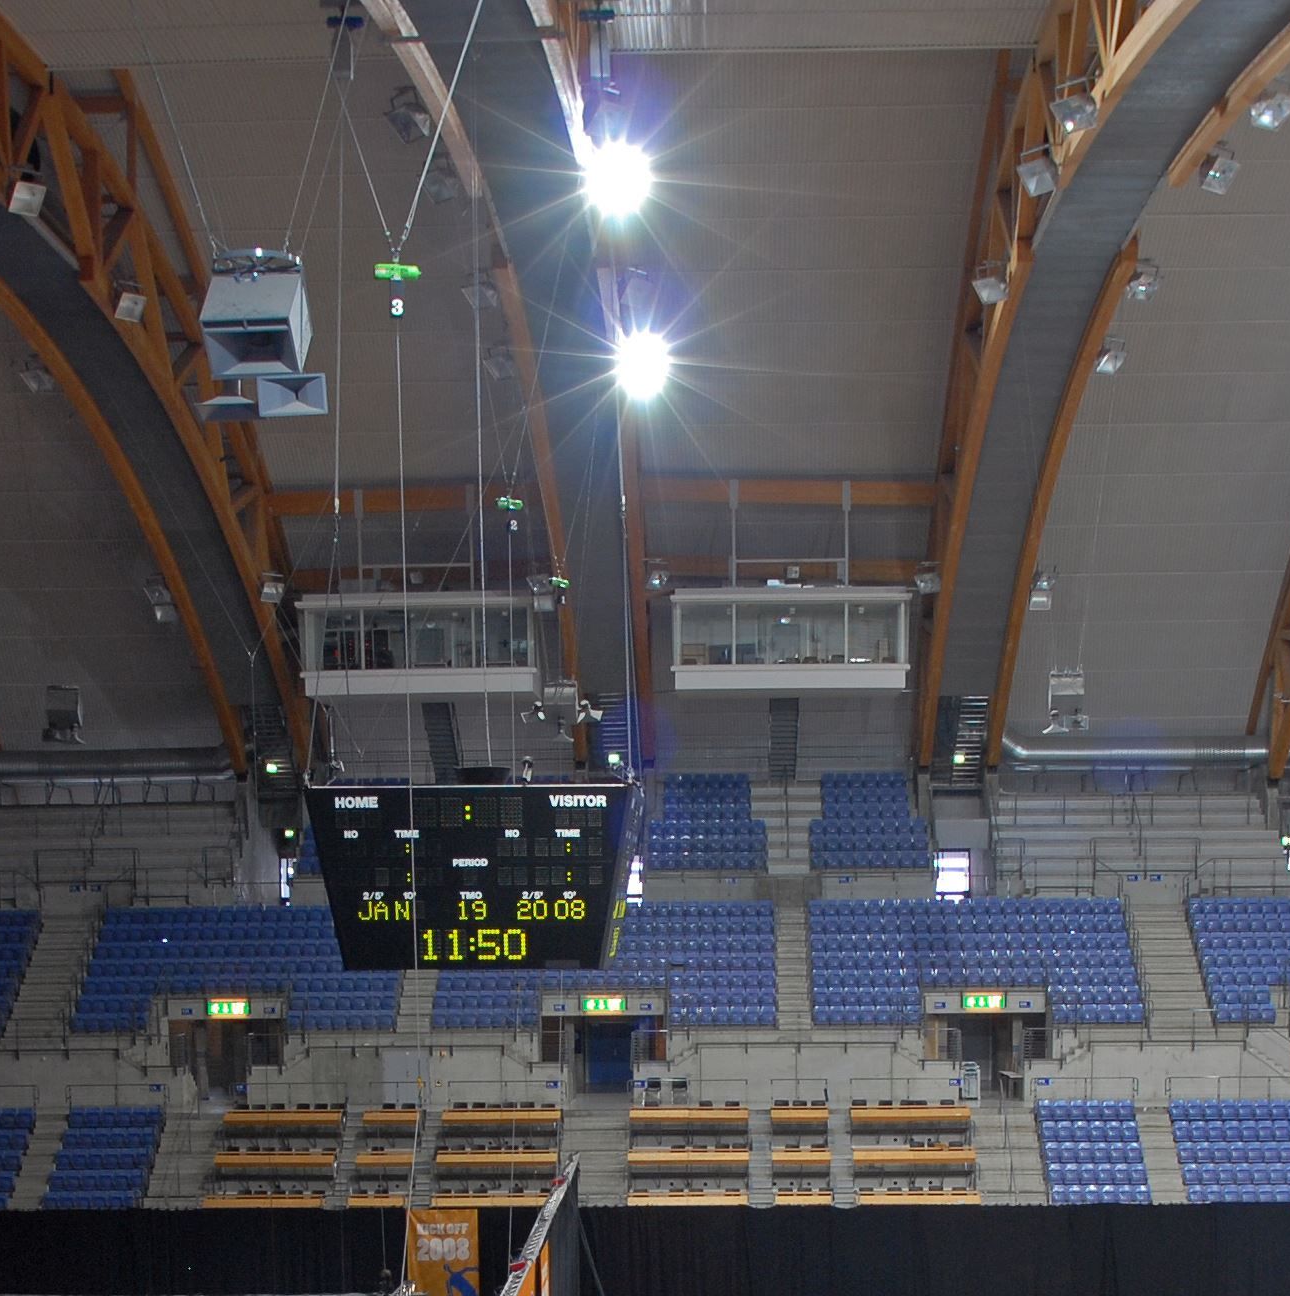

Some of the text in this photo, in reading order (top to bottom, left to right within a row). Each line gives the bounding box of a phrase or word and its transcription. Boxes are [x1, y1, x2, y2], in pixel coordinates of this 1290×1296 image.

[334, 796, 379, 809] HOME
[549, 795, 607, 808] VISITOR
[344, 830, 359, 838] NO
[394, 829, 420, 839] TIME
[505, 829, 519, 838] NO
[555, 829, 580, 838] TIME
[452, 858, 489, 867] PERIOD
[460, 891, 482, 900] TMO
[458, 900, 487, 921] 19
[423, 929, 527, 961] 11:50
[416, 1223, 469, 1235] KICK OFF
[416, 1238, 470, 1261] 2008
